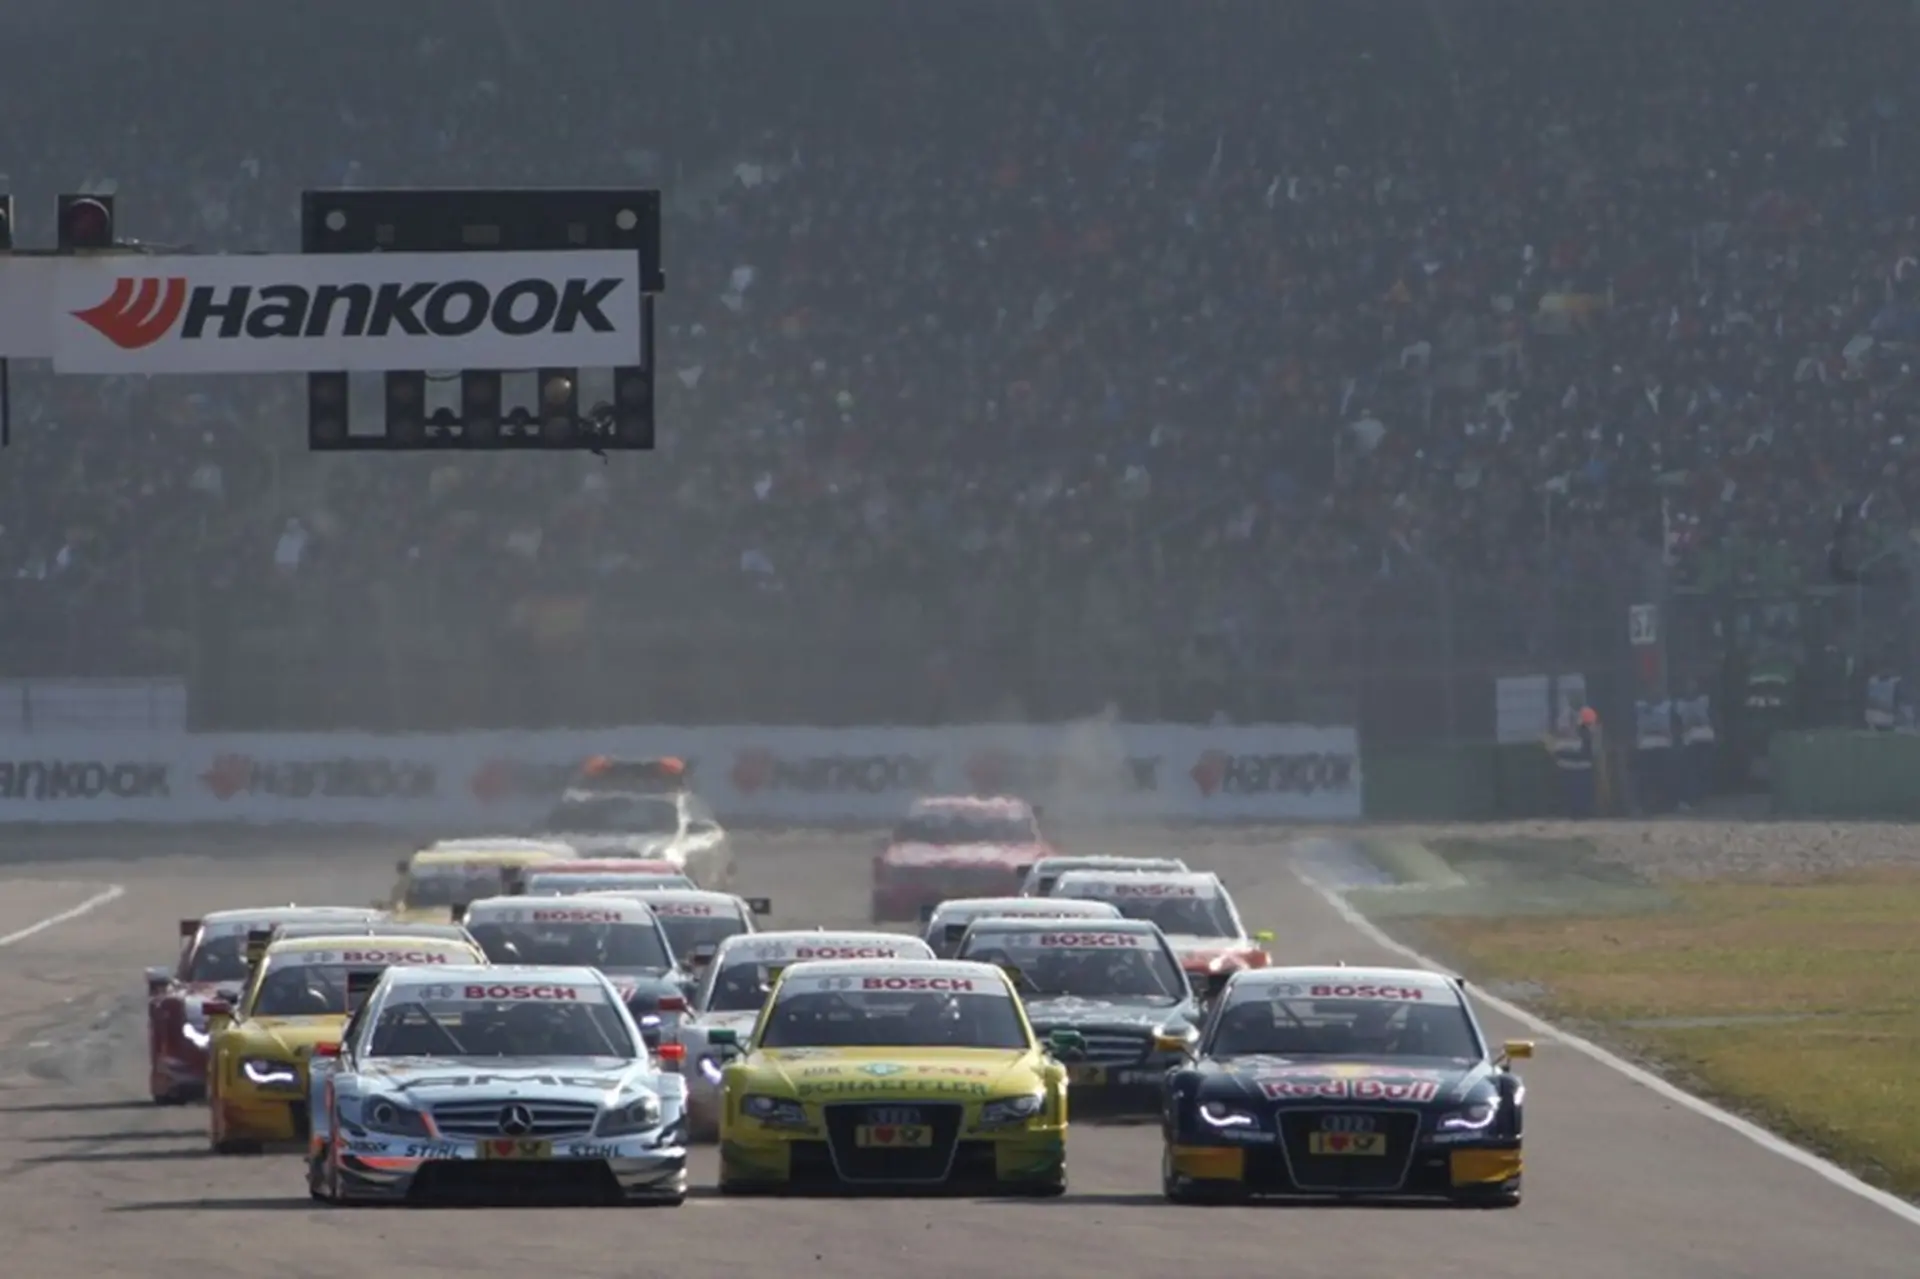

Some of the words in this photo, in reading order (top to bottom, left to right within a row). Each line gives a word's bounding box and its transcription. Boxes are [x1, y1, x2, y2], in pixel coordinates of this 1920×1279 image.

[1115, 885, 1195, 897] BOSCH
[532, 910, 623, 922] BOSCH
[1040, 934, 1138, 947] BOSCH
[343, 951, 446, 964] BOSCH
[795, 946, 895, 959] BOSCH
[862, 977, 973, 991] BOSCH
[463, 984, 577, 999] BOSCH
[1310, 985, 1423, 1000] BOSCH
[800, 1078, 989, 1097] SCHAEFFLER
[1261, 1079, 1347, 1099] Red
[1353, 1079, 1438, 1102] Bull
[405, 1143, 463, 1159] STIHL
[568, 1143, 625, 1158] STIHL
